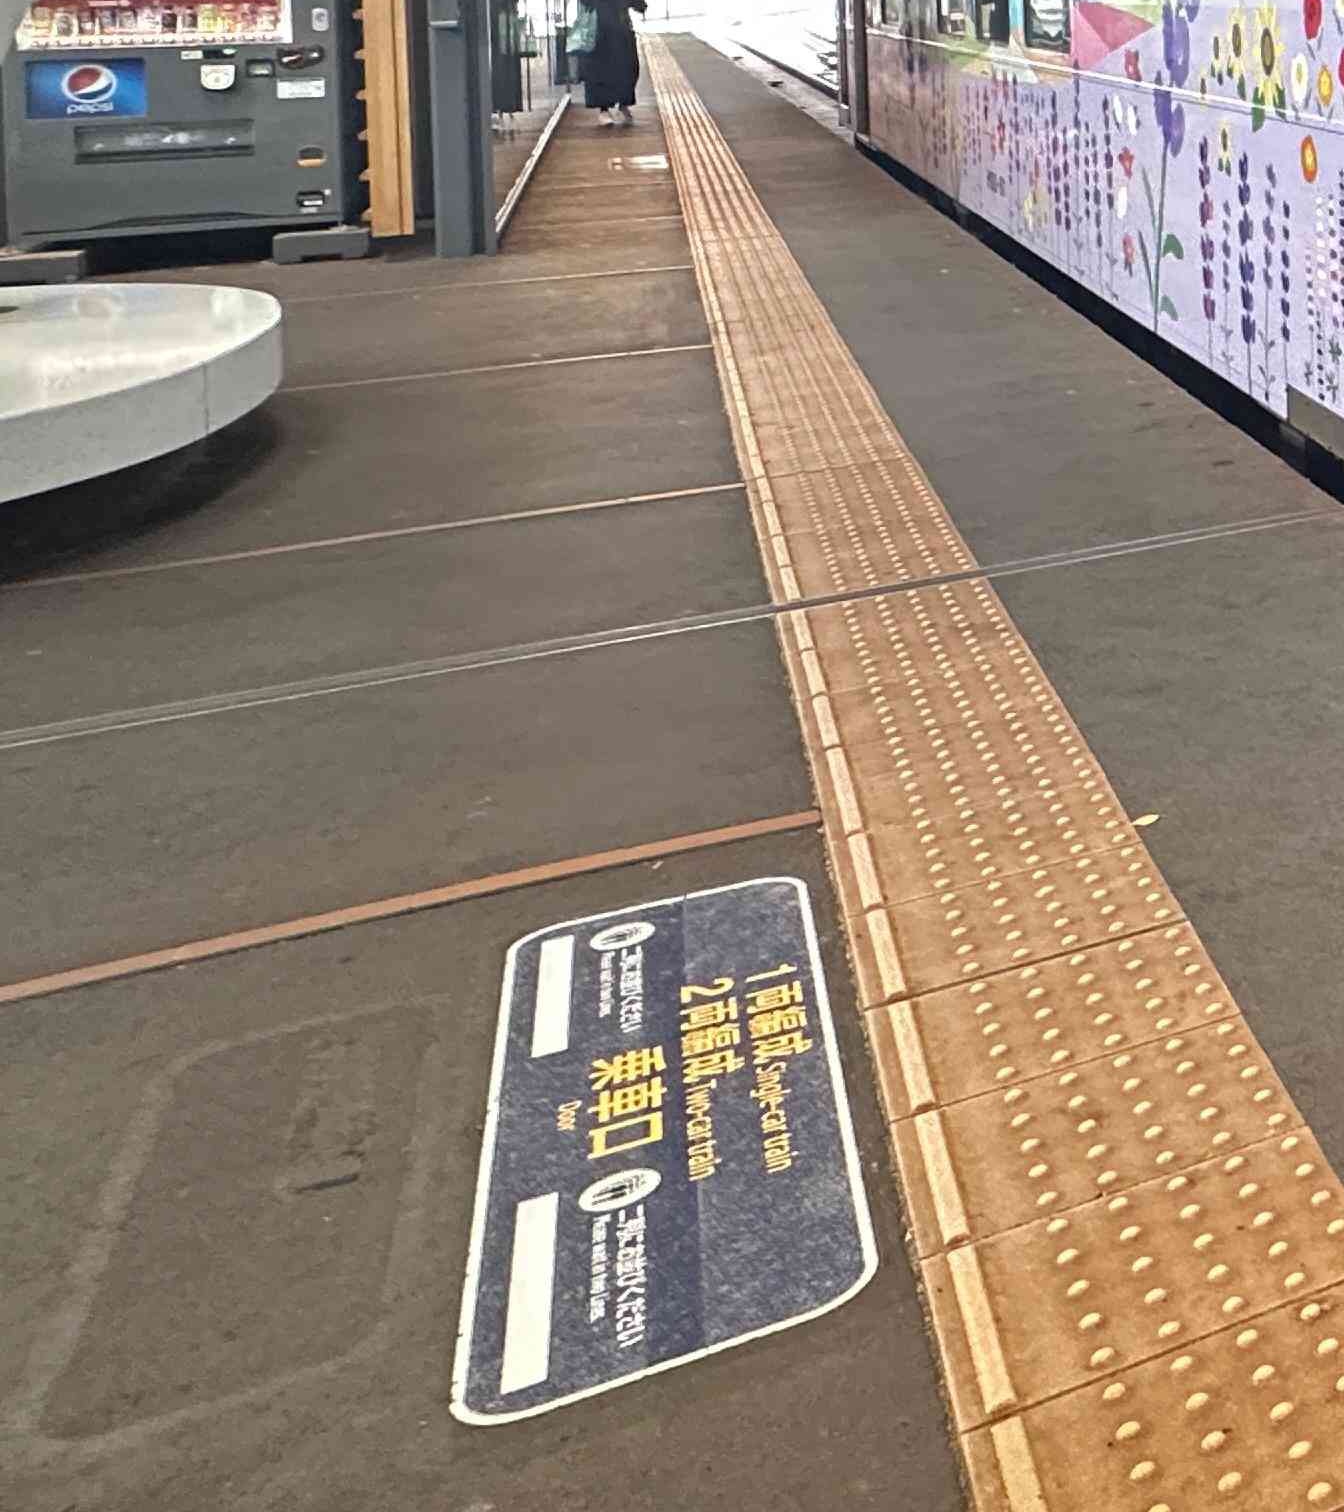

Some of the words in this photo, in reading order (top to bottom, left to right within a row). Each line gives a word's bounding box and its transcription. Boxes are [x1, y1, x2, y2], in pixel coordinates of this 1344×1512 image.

[556, 1100, 582, 1131] Door
[587, 1045, 668, 1160] 乗車口
[684, 1078, 718, 1141] Two-car
[750, 1061, 792, 1134] Single-car
[687, 1139, 722, 1182] train
[763, 1132, 799, 1174] train
